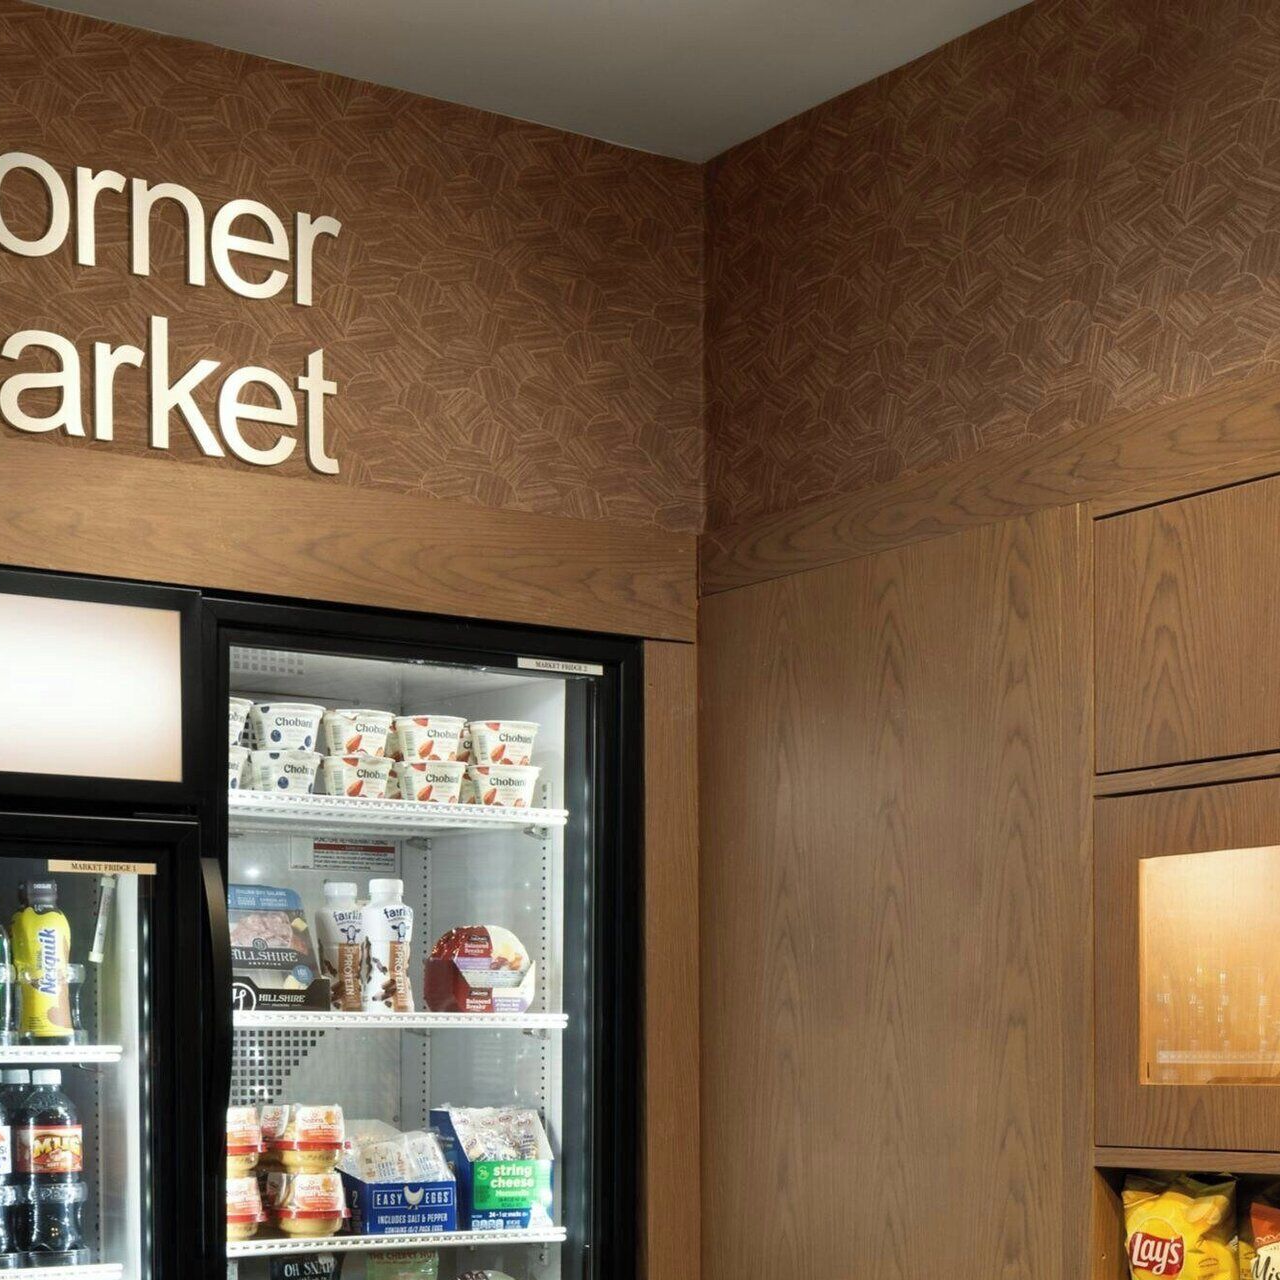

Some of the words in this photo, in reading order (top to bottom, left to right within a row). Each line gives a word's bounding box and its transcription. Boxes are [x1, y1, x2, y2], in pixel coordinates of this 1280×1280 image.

[71, 862, 103, 872] MARKET
[104, 863, 132, 873] FRIDGE
[38, 928, 56, 995] Nesquik
[344, 950, 355, 996] PROTEIN
[395, 950, 406, 994] PROTEIN
[258, 993, 306, 1003] HILLSHIRE
[492, 1164, 533, 1179] string
[490, 1177, 535, 1189] cheese
[375, 1192, 403, 1206] EASY
[425, 1191, 449, 1204] EGGS
[377, 1214, 407, 1225] INCLUDES
[408, 1214, 421, 1224] SALT
[427, 1212, 448, 1224] PEPPER
[1131, 1232, 1183, 1276] Lay's
[284, 1263, 300, 1279] OH
